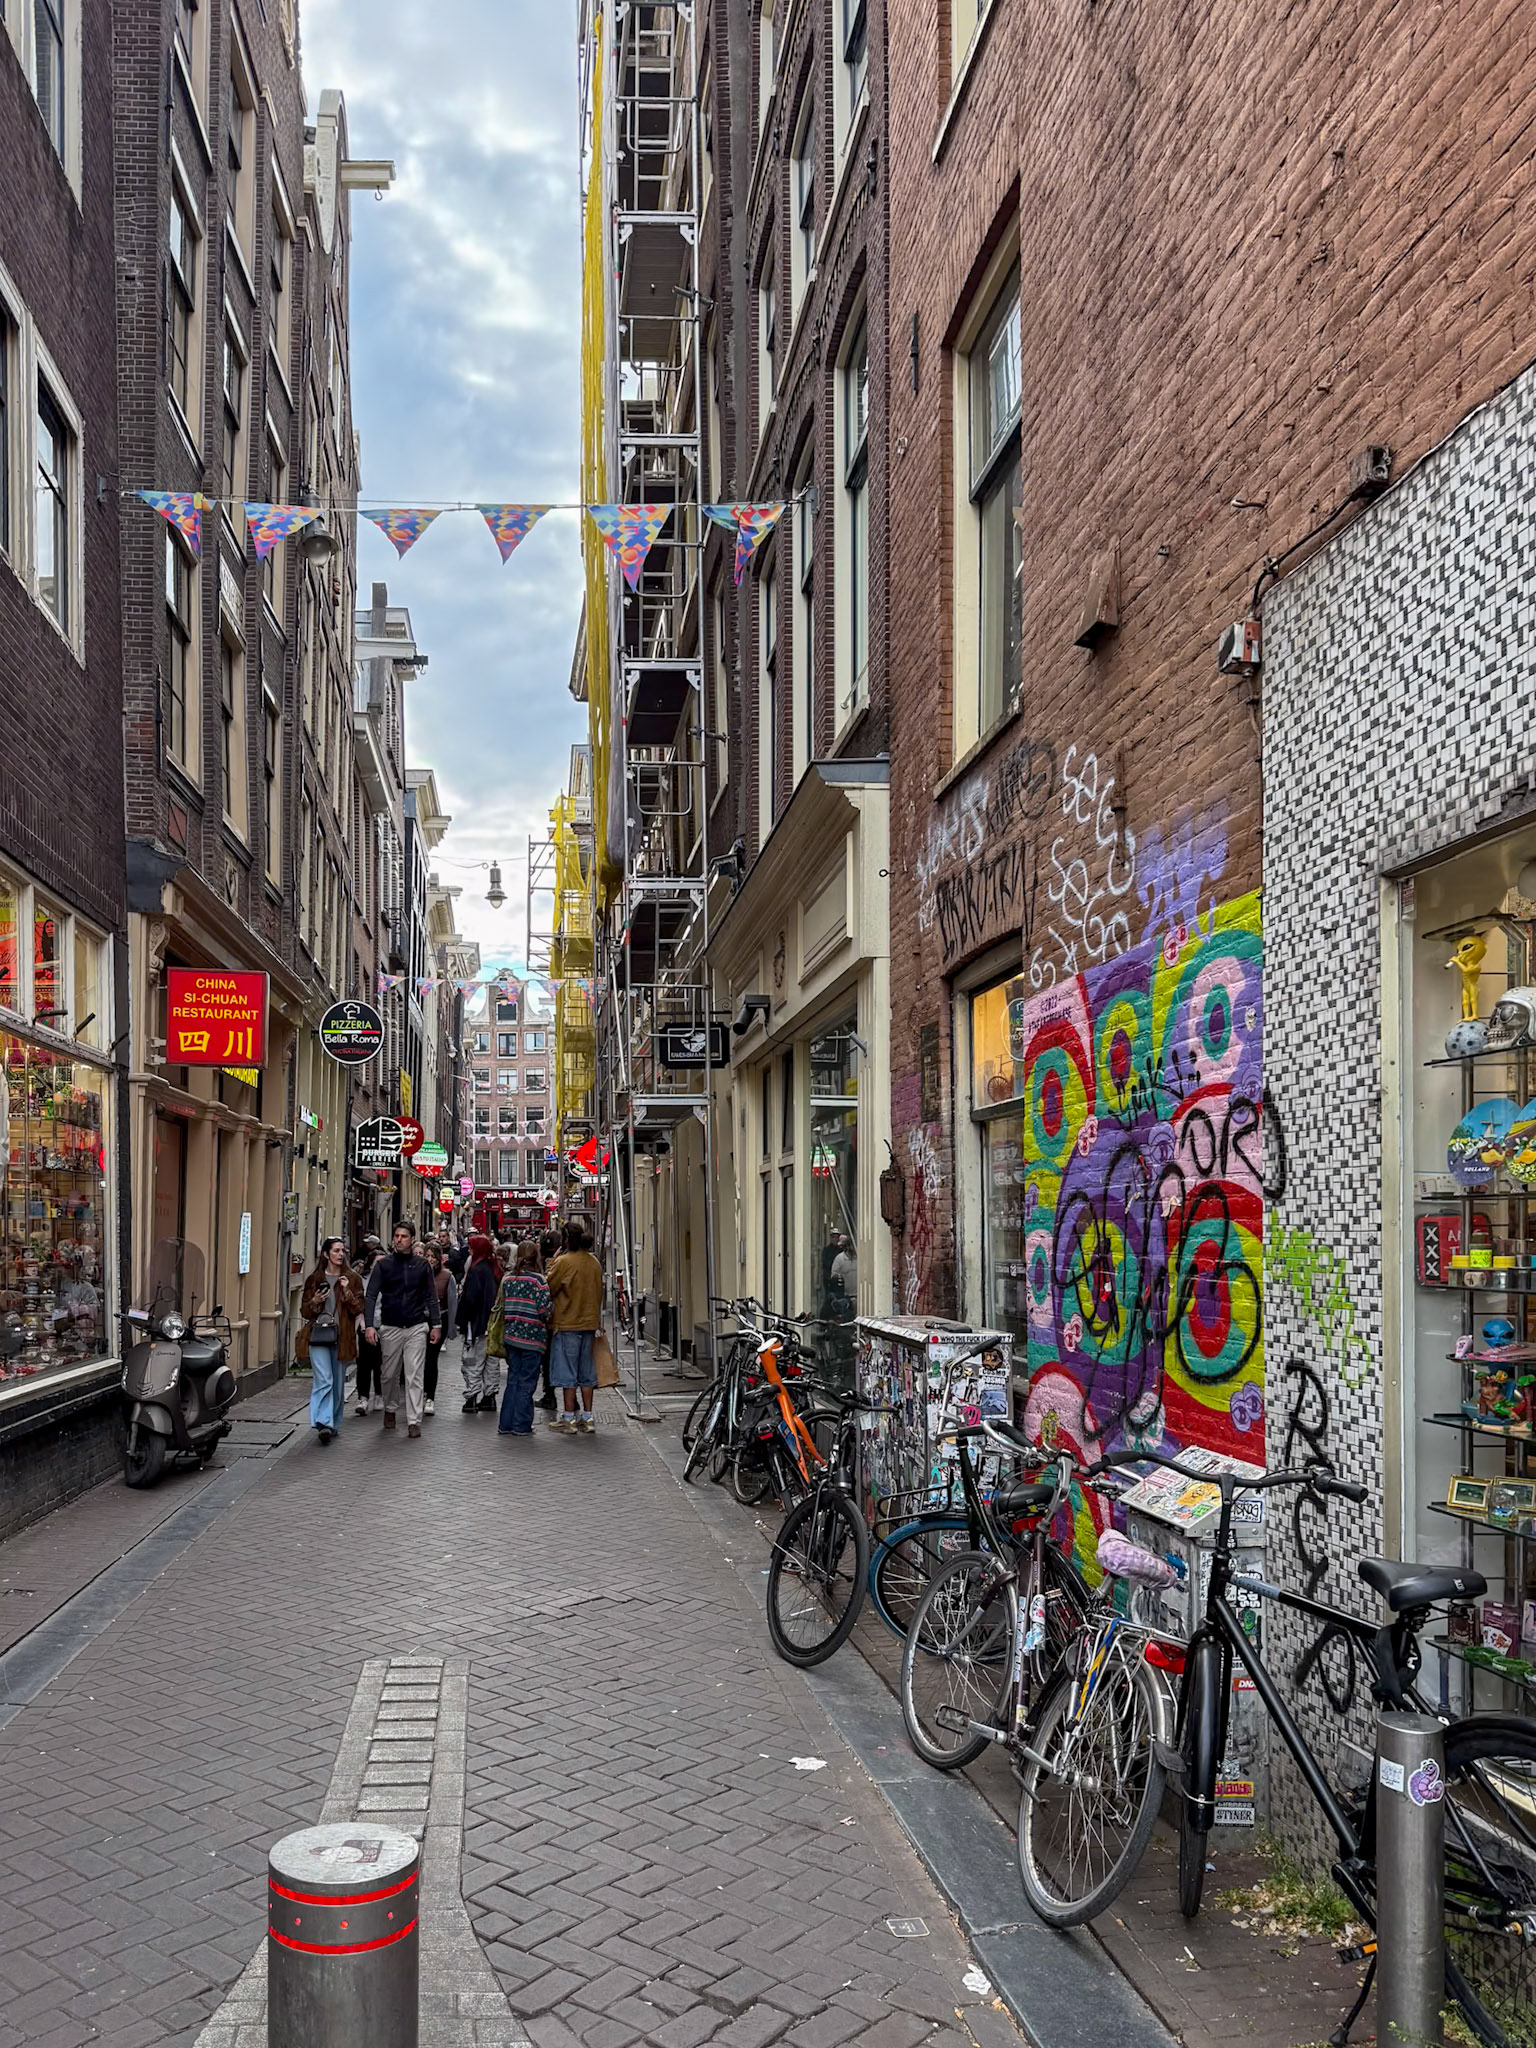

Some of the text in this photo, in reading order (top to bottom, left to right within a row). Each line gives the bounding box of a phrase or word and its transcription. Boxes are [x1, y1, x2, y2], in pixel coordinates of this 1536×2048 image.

[196, 978, 237, 990] CHINA
[184, 993, 248, 1005] SI-CHUAN
[172, 1007, 259, 1020] RESTAURANT
[331, 1020, 372, 1029] PIZZERIA
[178, 1027, 253, 1060] 四川
[324, 1034, 380, 1044] Bella Roma
[940, 1335, 955, 1343] WHO
[1013, 1596, 1027, 1682] BATAVUS
[1216, 1809, 1252, 1821] STYNER
